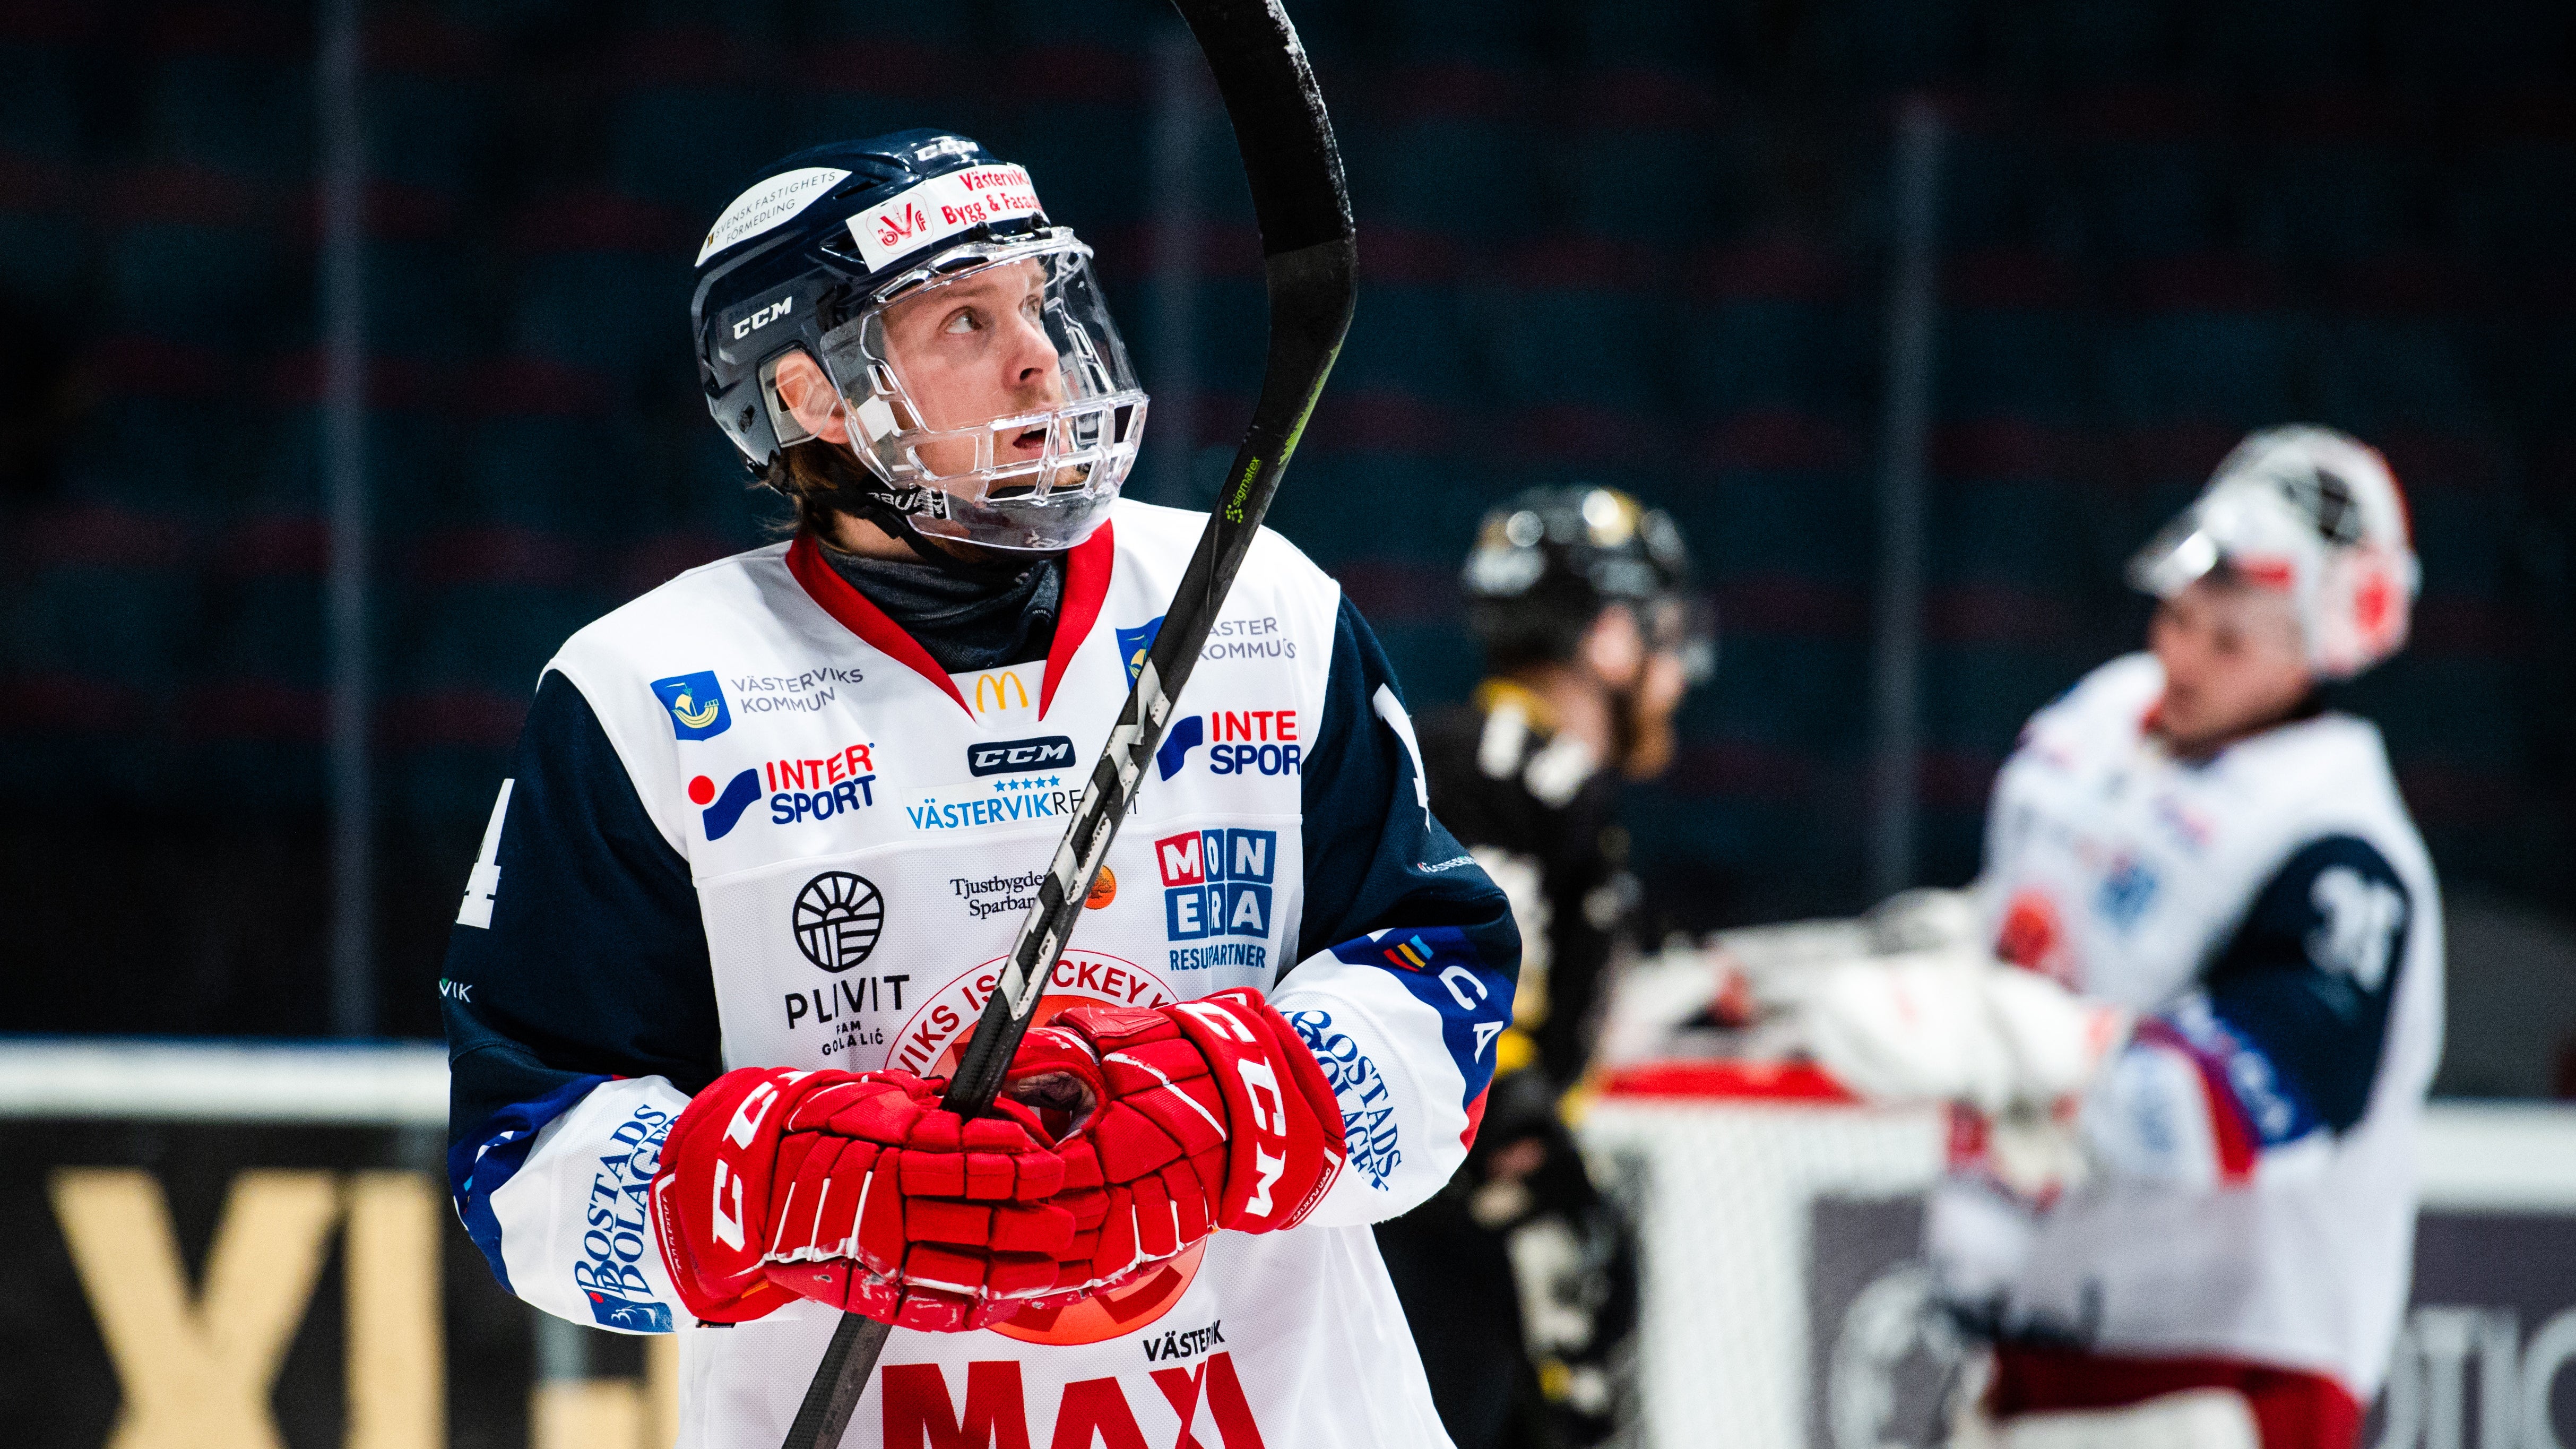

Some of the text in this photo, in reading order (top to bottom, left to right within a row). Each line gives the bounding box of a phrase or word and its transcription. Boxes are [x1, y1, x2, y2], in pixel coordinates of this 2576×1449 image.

[716, 171, 836, 237] SVENSK FASTIGHETS
[726, 199, 796, 244] FÖRMEDLING
[941, 202, 987, 225] Bygg
[986, 194, 1001, 212] &
[732, 296, 792, 340] CCM
[731, 667, 864, 693] VÄSTERVIKS
[741, 686, 836, 714] KOMMUN
[1212, 710, 1301, 742] INTE
[766, 744, 874, 792] INTER
[975, 743, 1070, 768] CCM
[771, 774, 877, 825] SPORT
[1161, 836, 1267, 881] MON
[1176, 890, 1264, 934] ERA
[785, 974, 910, 1030] PLIVIT
[822, 1028, 884, 1056] GOLALIĆ
[836, 1021, 861, 1036] FAM
[1175, 1002, 1287, 1218] CCM
[1291, 1010, 1402, 1178] BOSTADS
[574, 1104, 668, 1298] BOSTADS
